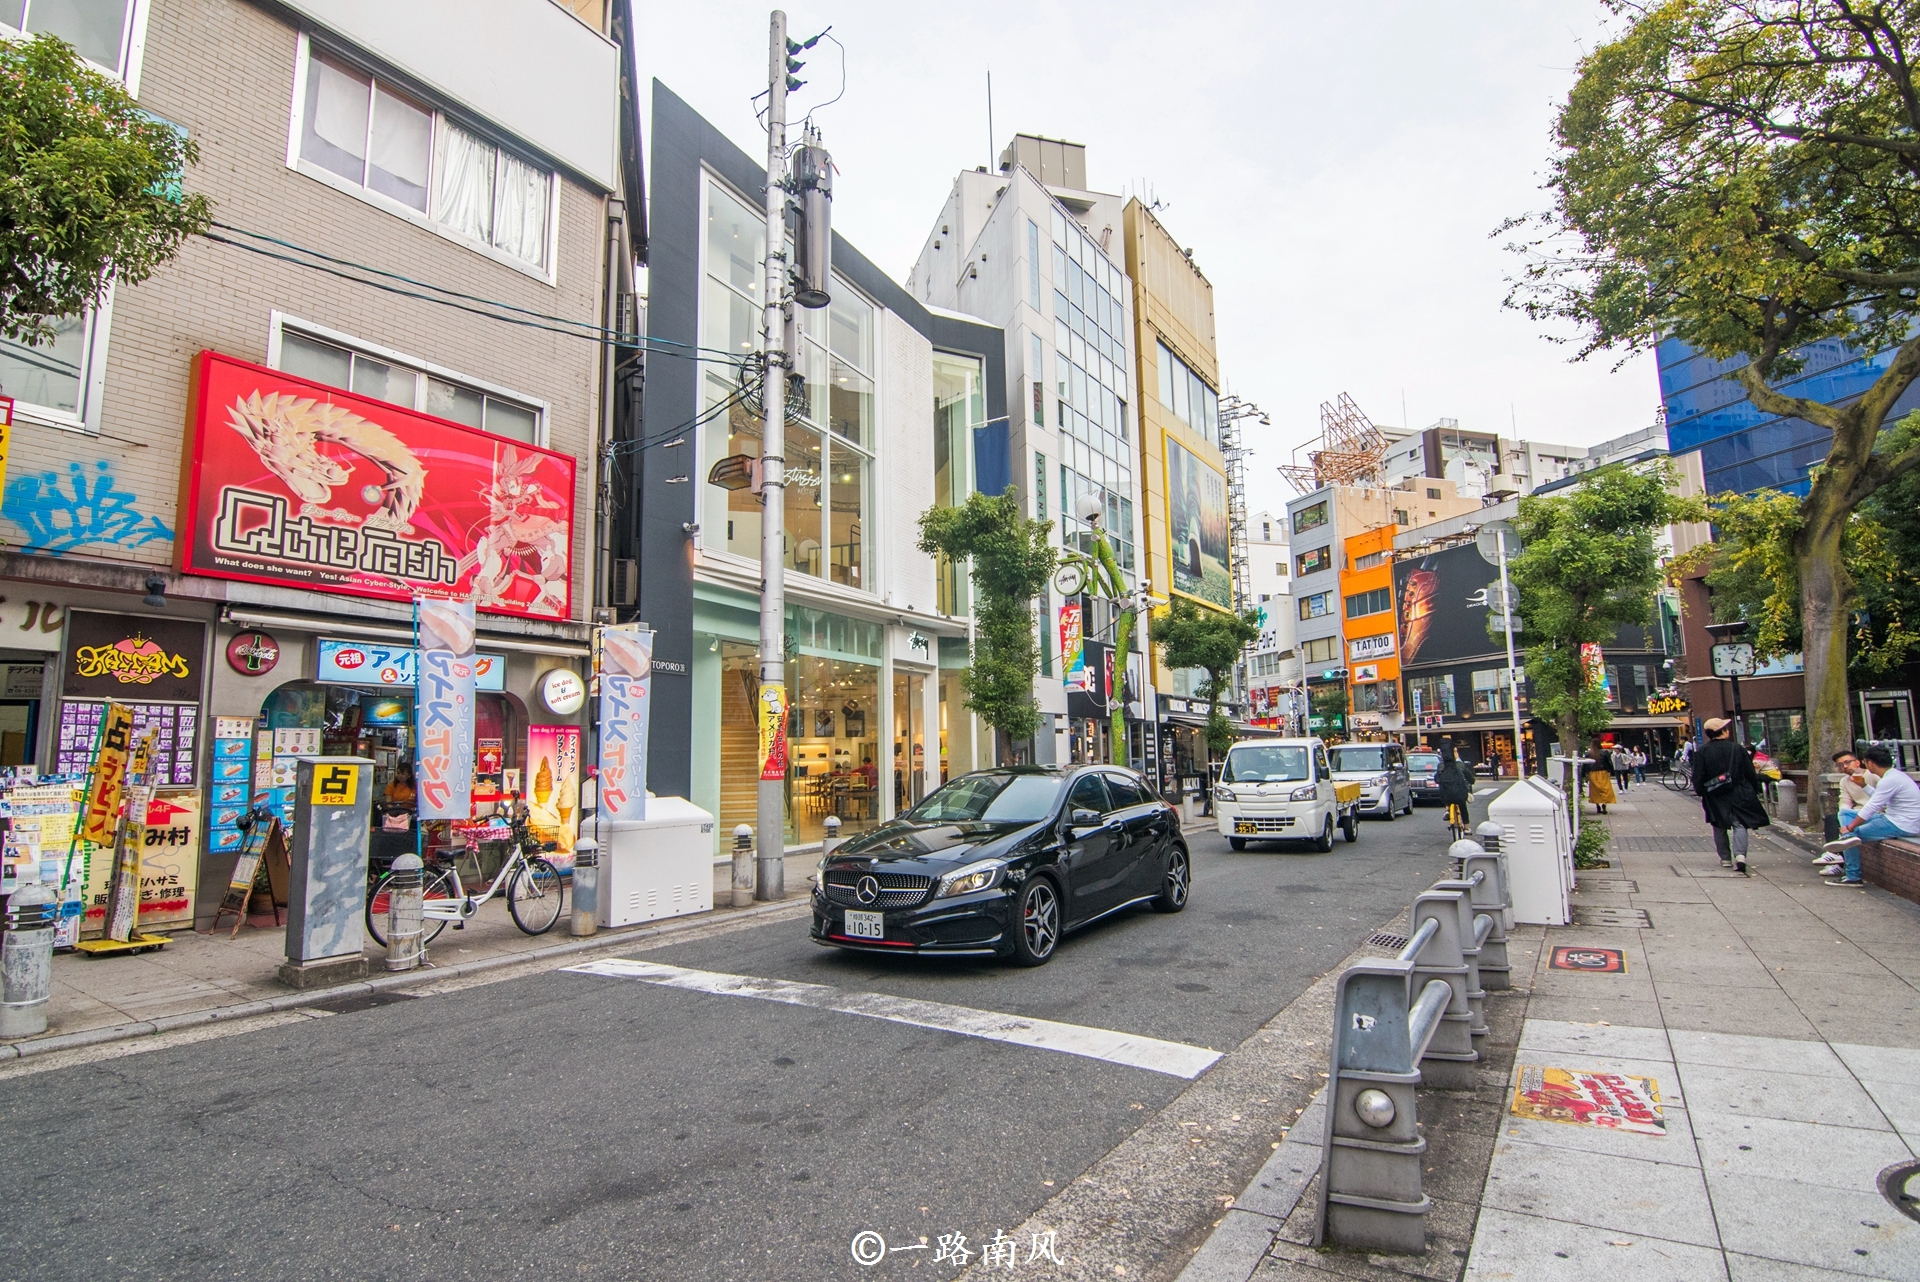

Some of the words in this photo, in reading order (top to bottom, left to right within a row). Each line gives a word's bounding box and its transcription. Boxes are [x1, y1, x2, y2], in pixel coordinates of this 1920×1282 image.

[214, 556, 240, 567] What
[241, 560, 265, 570] does
[267, 563, 283, 573] she
[285, 567, 313, 577] want?
[319, 571, 337, 581] Yes!
[339, 574, 363, 584] Asian
[416, 585, 449, 597] Welcome
[1356, 636, 1389, 651] TATTOO
[338, 653, 362, 666] 元祖
[652, 660, 680, 672] TOPORO
[382, 669, 396, 682] &
[561, 678, 573, 688] dog
[550, 696, 562, 705] soft
[562, 690, 581, 701] cream
[320, 766, 351, 795] 占
[853, 921, 881, 937] 10-15
